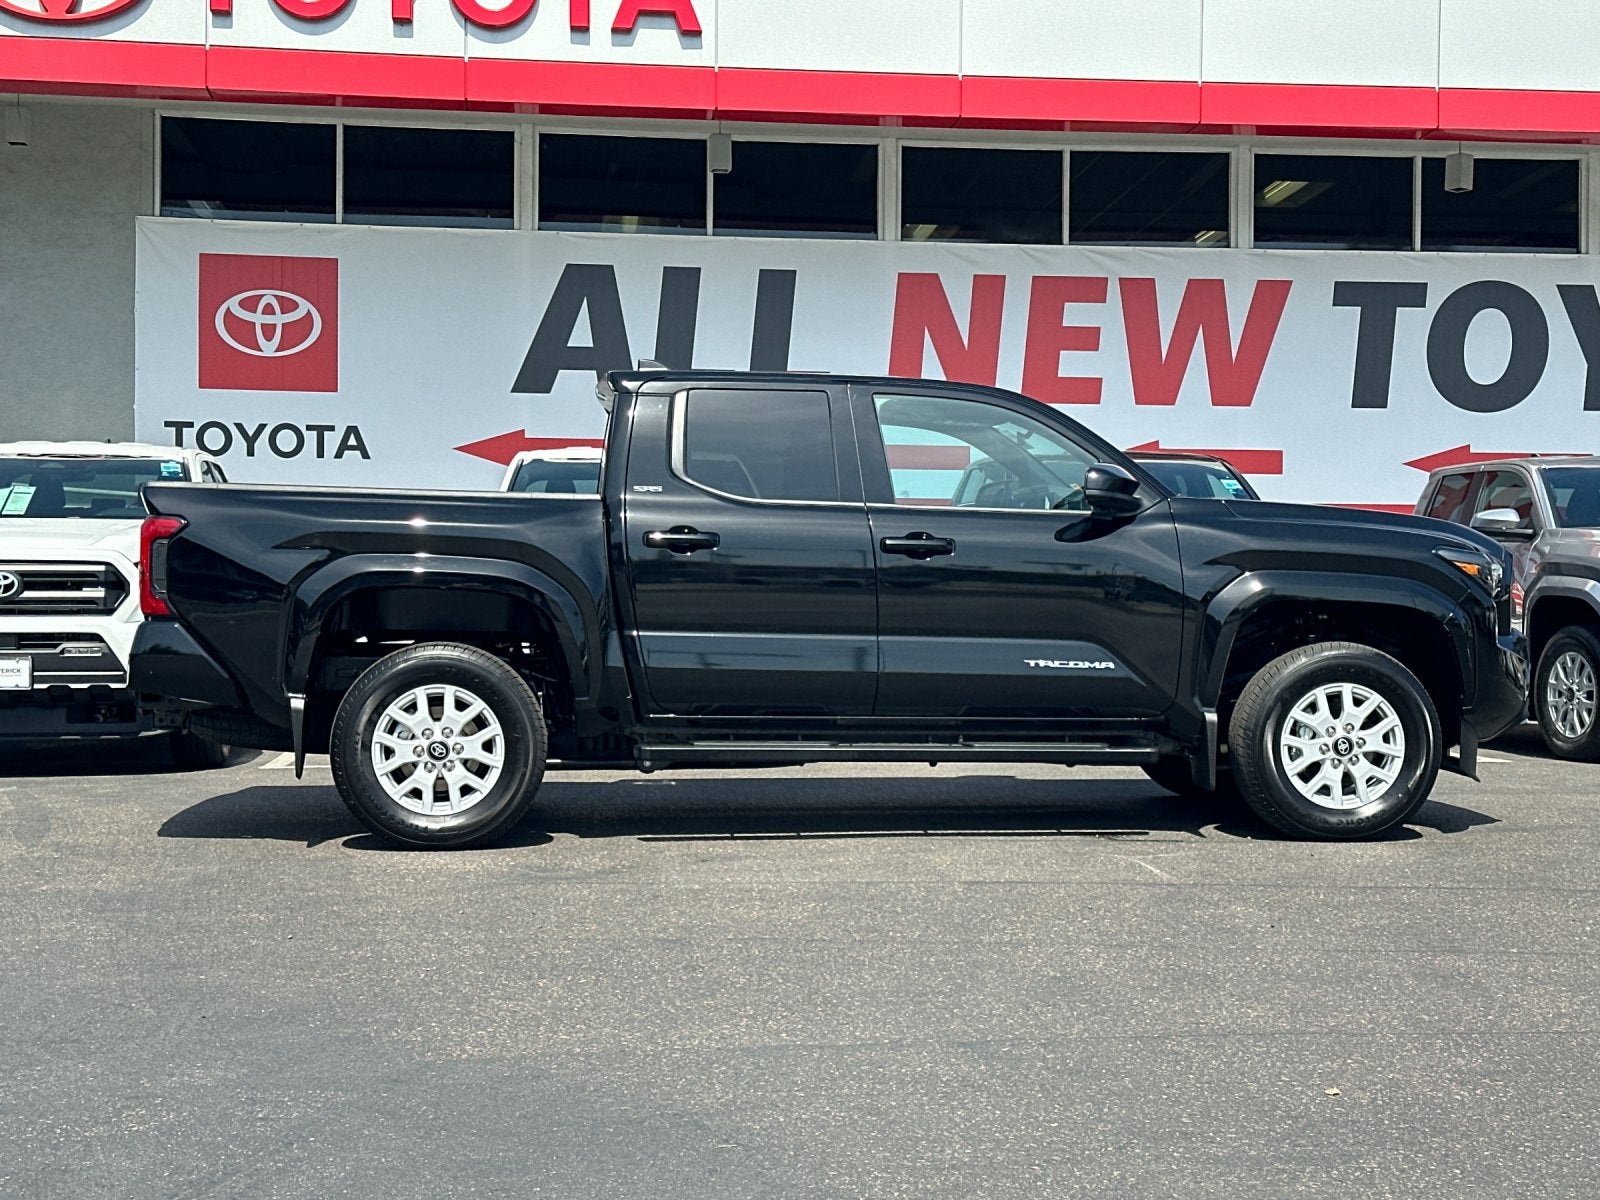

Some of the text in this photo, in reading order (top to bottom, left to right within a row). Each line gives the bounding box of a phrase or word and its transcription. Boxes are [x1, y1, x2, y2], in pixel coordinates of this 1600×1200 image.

[510, 263, 797, 394] ALL
[888, 272, 1293, 406] NEW
[164, 420, 371, 459] TOYOTA
[1024, 659, 1115, 669] TACOMA
